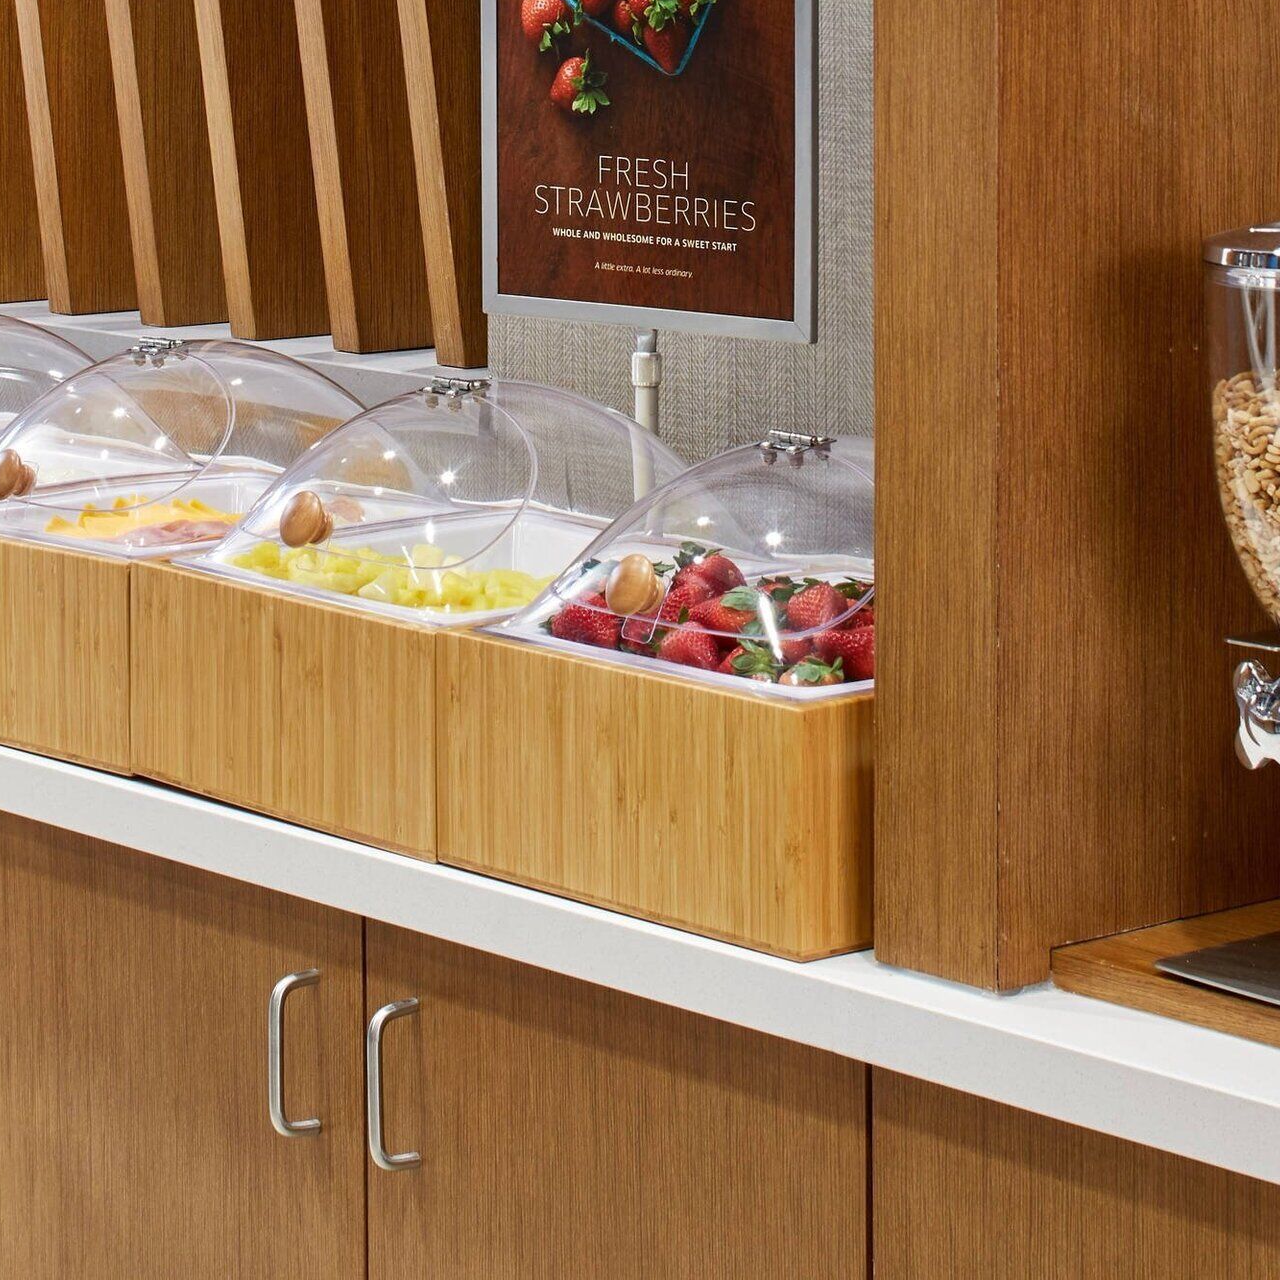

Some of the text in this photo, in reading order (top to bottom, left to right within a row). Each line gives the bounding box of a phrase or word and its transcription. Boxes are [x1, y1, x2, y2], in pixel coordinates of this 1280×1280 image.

[598, 155, 689, 191] FRESH
[534, 184, 757, 232] STRAWBERRIES
[552, 227, 737, 252] WHOLE AND WHOLESOME FOR A SWEET START
[594, 261, 600, 270] A
[601, 262, 616, 271] little
[635, 265, 641, 273] A
[642, 265, 651, 275] lot
[652, 266, 664, 276] less
[665, 267, 694, 279] ordinary.
